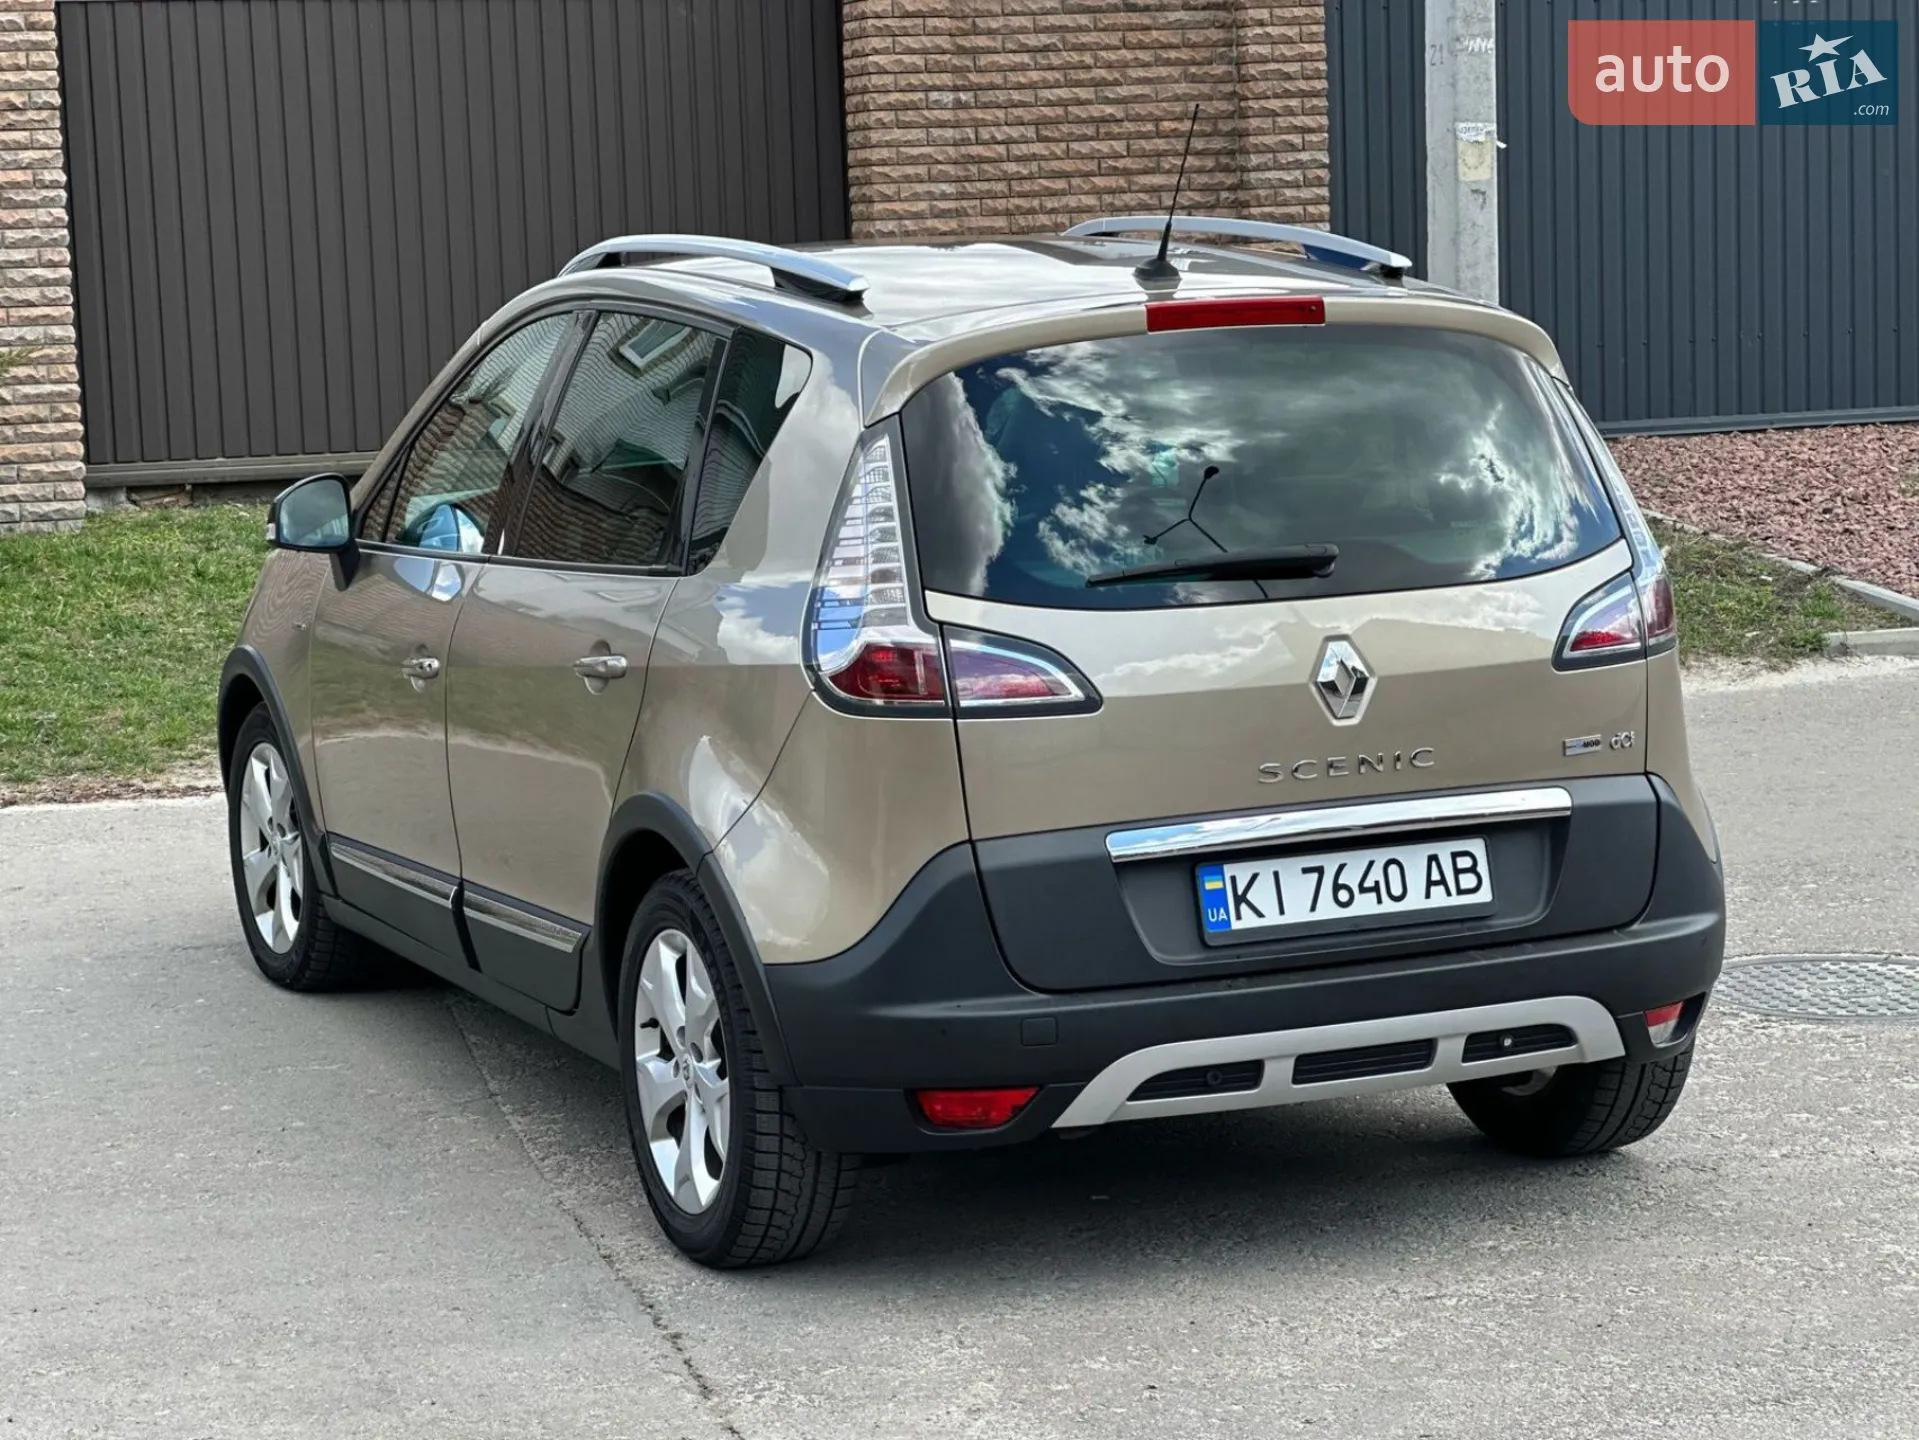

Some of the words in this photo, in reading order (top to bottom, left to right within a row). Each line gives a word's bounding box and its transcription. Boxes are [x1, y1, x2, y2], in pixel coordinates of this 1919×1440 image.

[1258, 747, 1435, 784] SCENIC
[1229, 870, 1286, 921] KI
[1301, 857, 1408, 913] 7640
[1424, 849, 1483, 900] AB
[1207, 907, 1228, 922] UA
